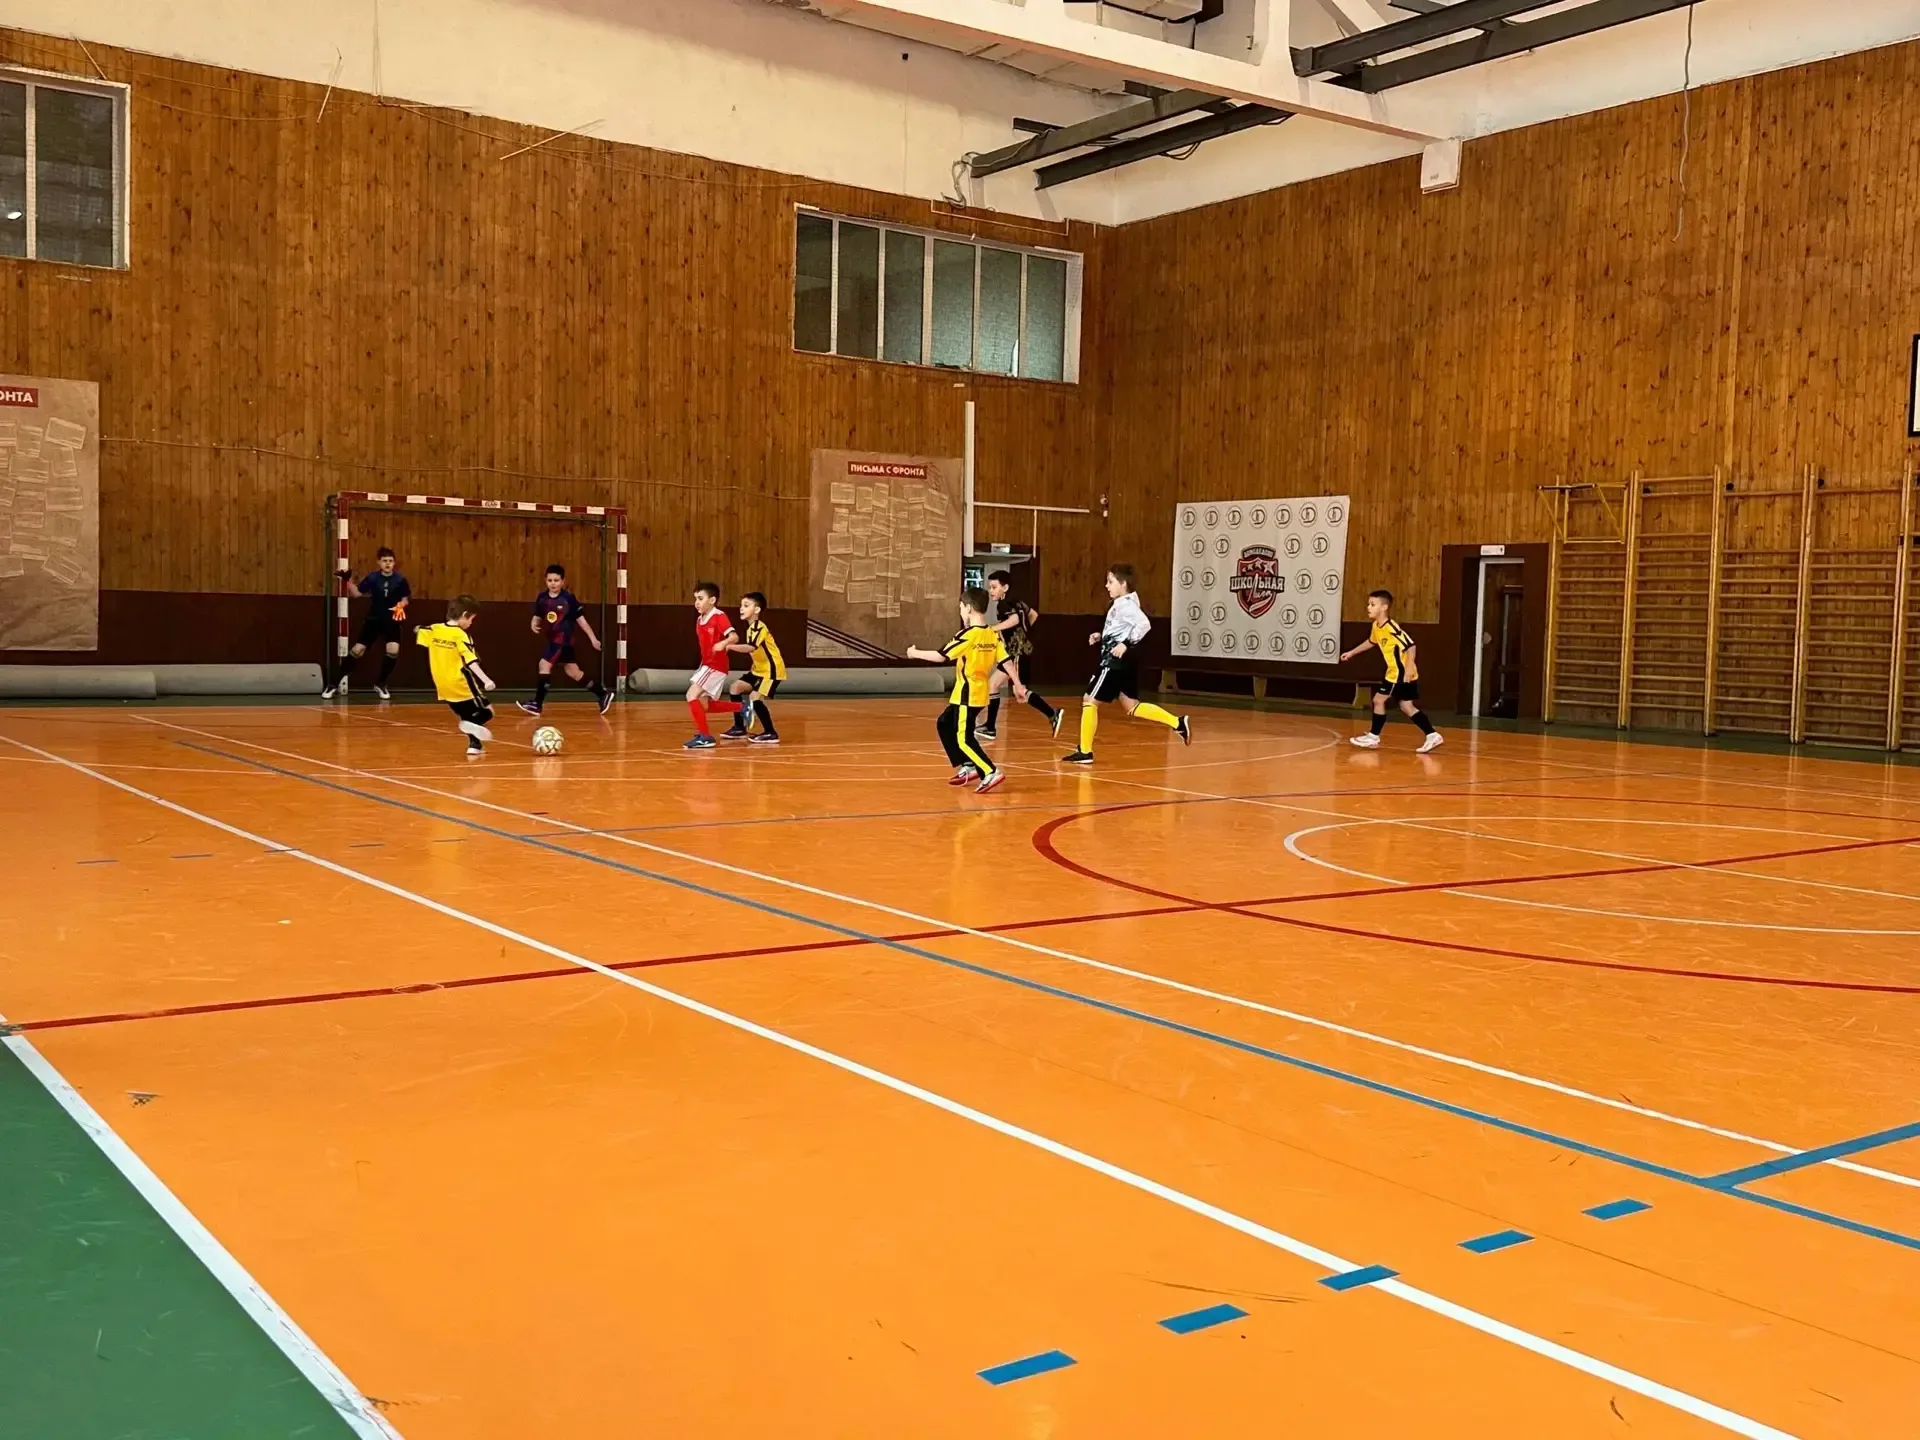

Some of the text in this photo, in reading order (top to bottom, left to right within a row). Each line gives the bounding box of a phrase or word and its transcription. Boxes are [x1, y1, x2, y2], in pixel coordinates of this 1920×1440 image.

[851, 464, 885, 474] ПИСЬМА
[893, 466, 925, 476] ФРОНТА
[1230, 575, 1284, 591] ШКОЛЬНАЯ
